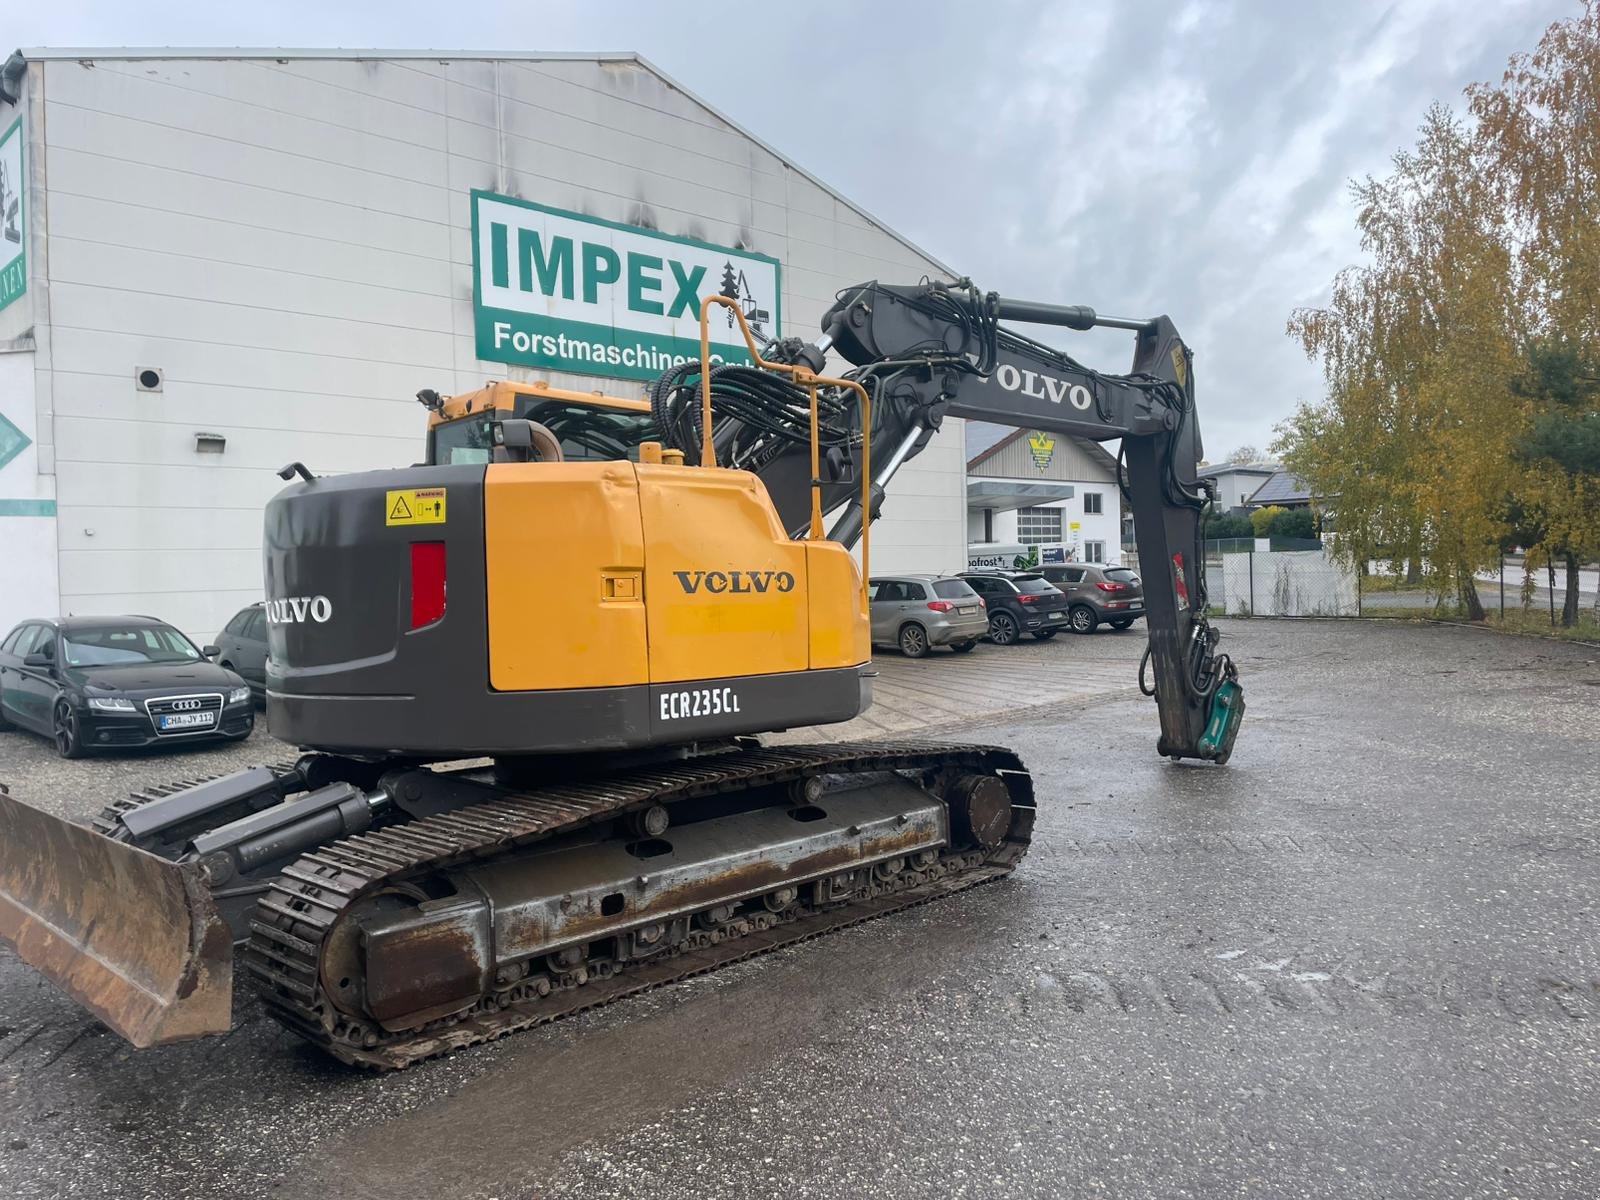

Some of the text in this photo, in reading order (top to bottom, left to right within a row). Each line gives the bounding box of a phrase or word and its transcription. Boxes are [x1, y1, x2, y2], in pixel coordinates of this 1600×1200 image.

[0, 260, 23, 302] NEN
[491, 222, 707, 322] IMPEX
[673, 571, 795, 593] VOLVO
